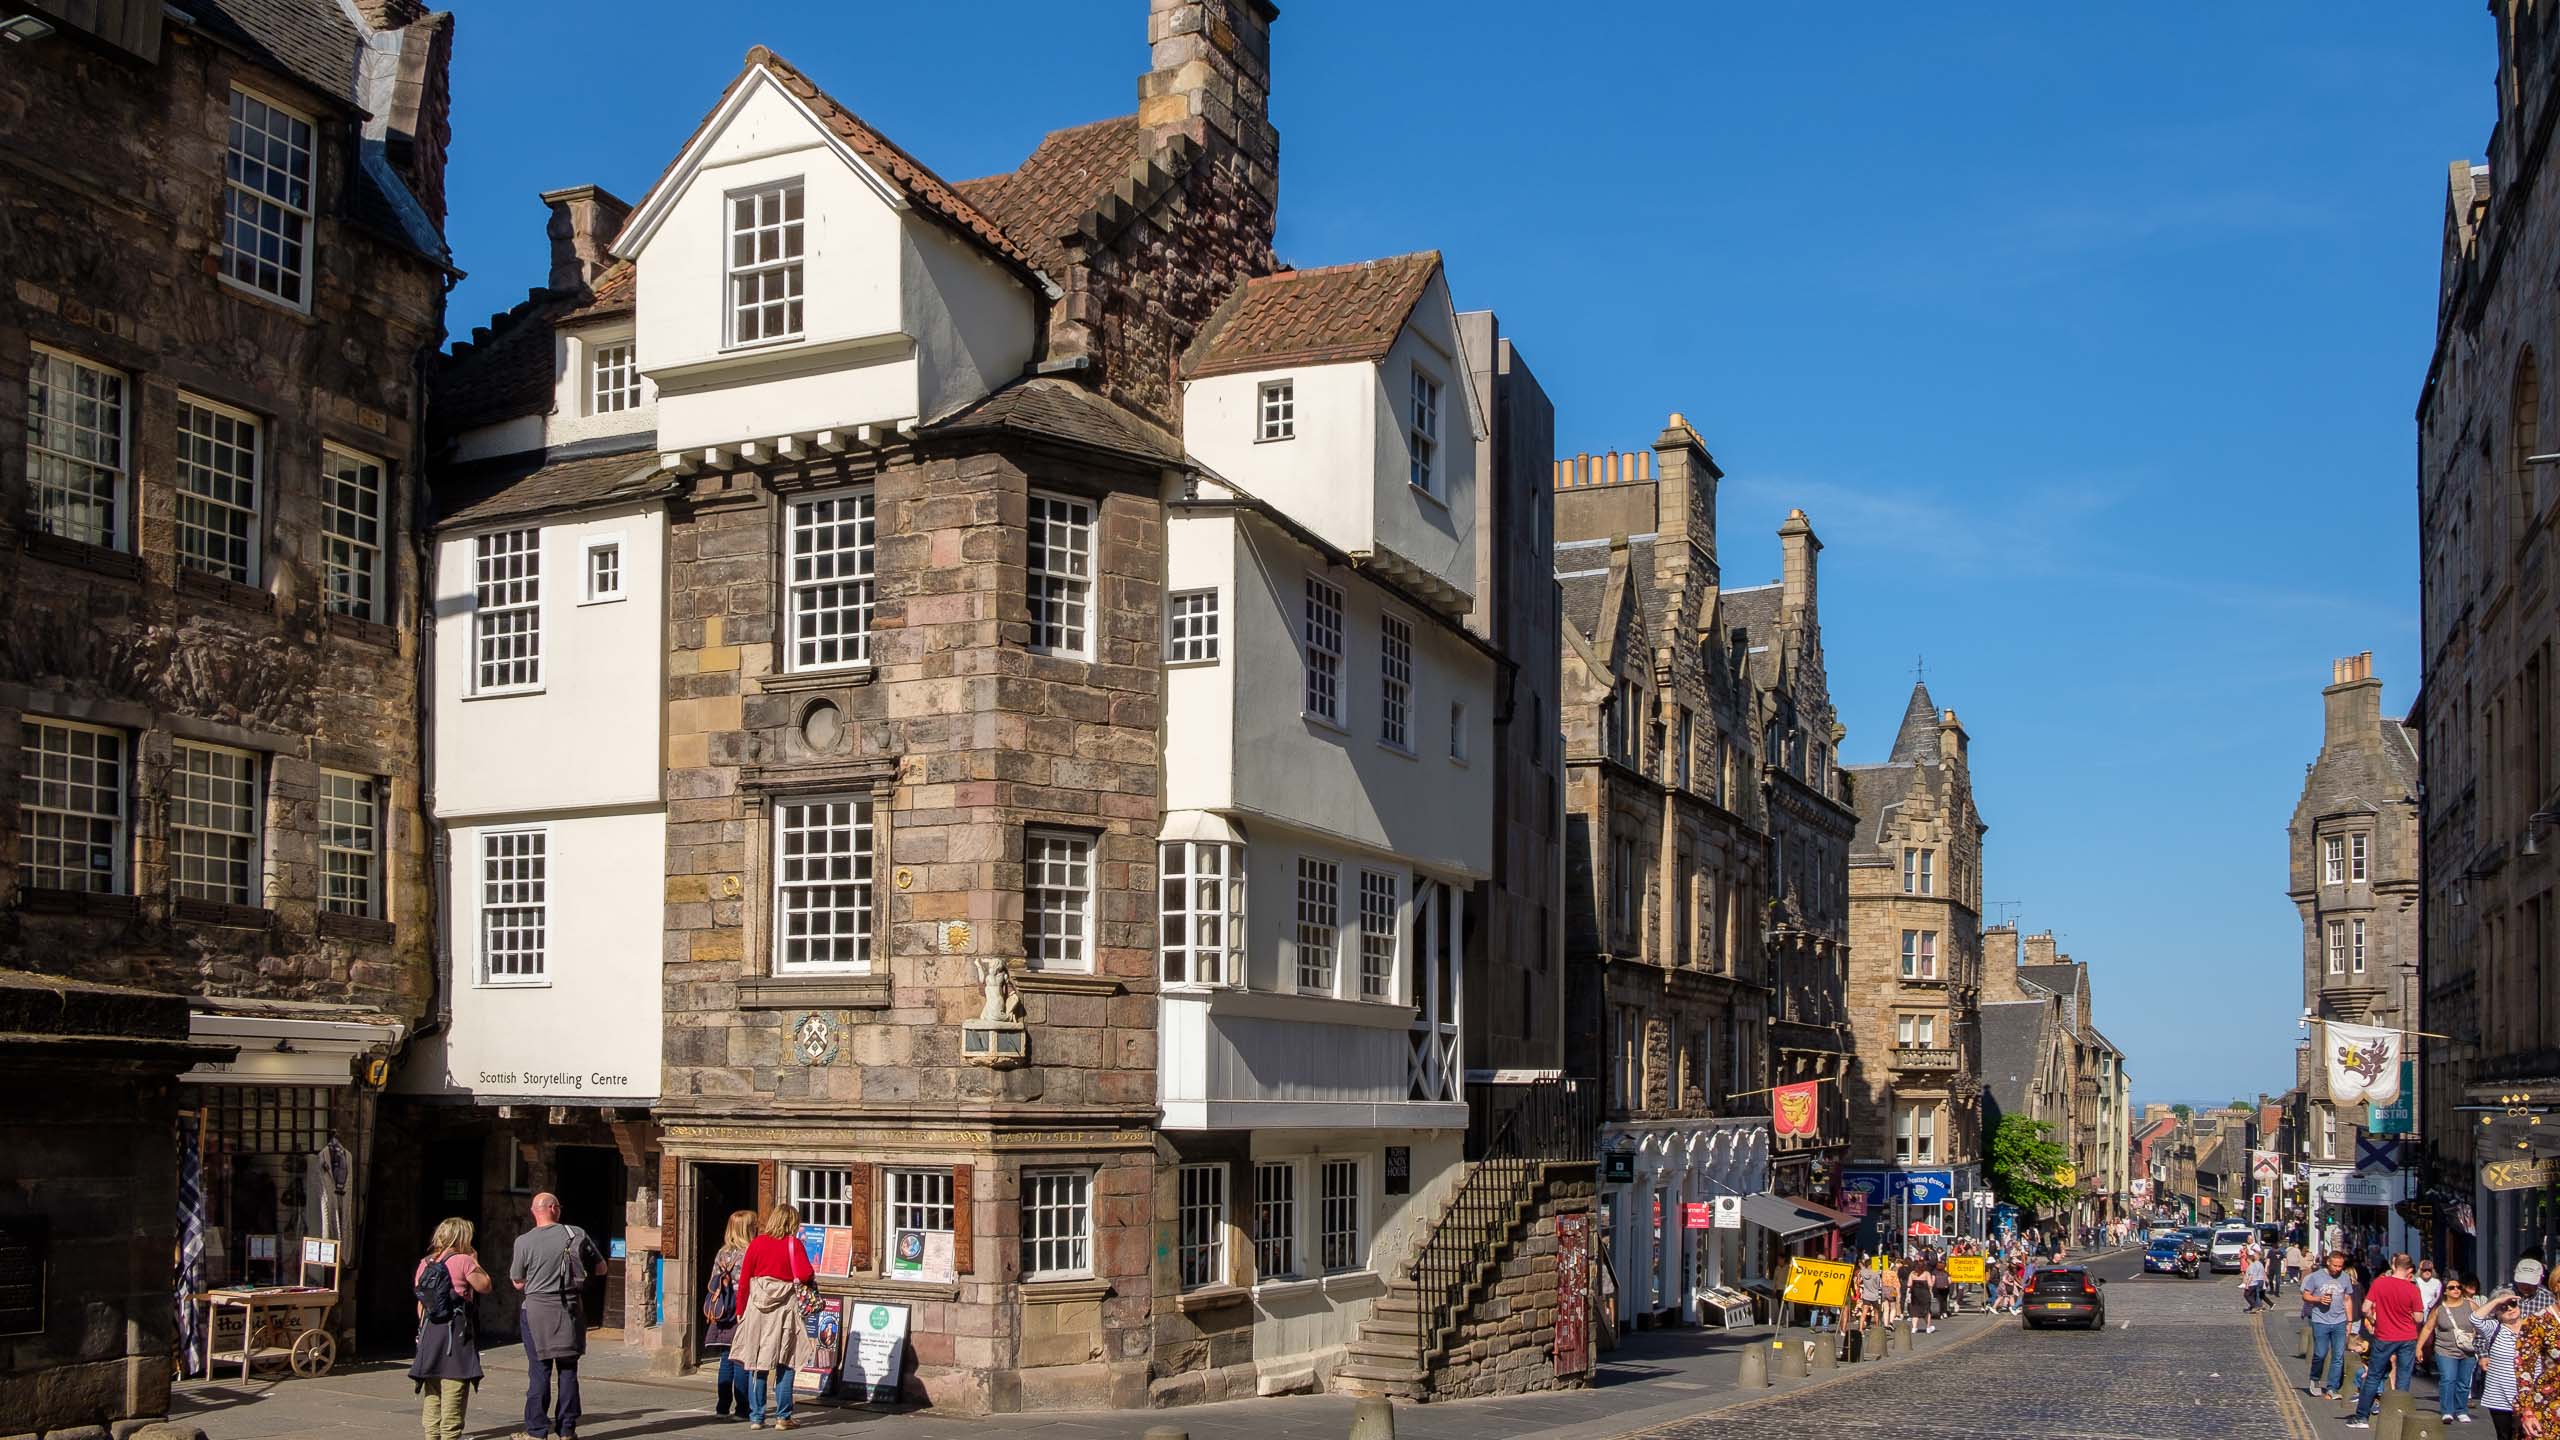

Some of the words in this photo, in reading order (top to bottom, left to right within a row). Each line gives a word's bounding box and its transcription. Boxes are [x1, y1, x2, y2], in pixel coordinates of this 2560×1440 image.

[479, 1071, 517, 1084] Scottish
[523, 1072, 582, 1089] Storytelling
[591, 1072, 628, 1086] Centre
[2375, 1109, 2408, 1119] BISTRO
[1053, 1132, 1084, 1142] SELF
[1387, 1167, 1408, 1177] HOUSE
[2326, 1180, 2377, 1197] ragamuffin
[1796, 1265, 1846, 1280] Diversion
